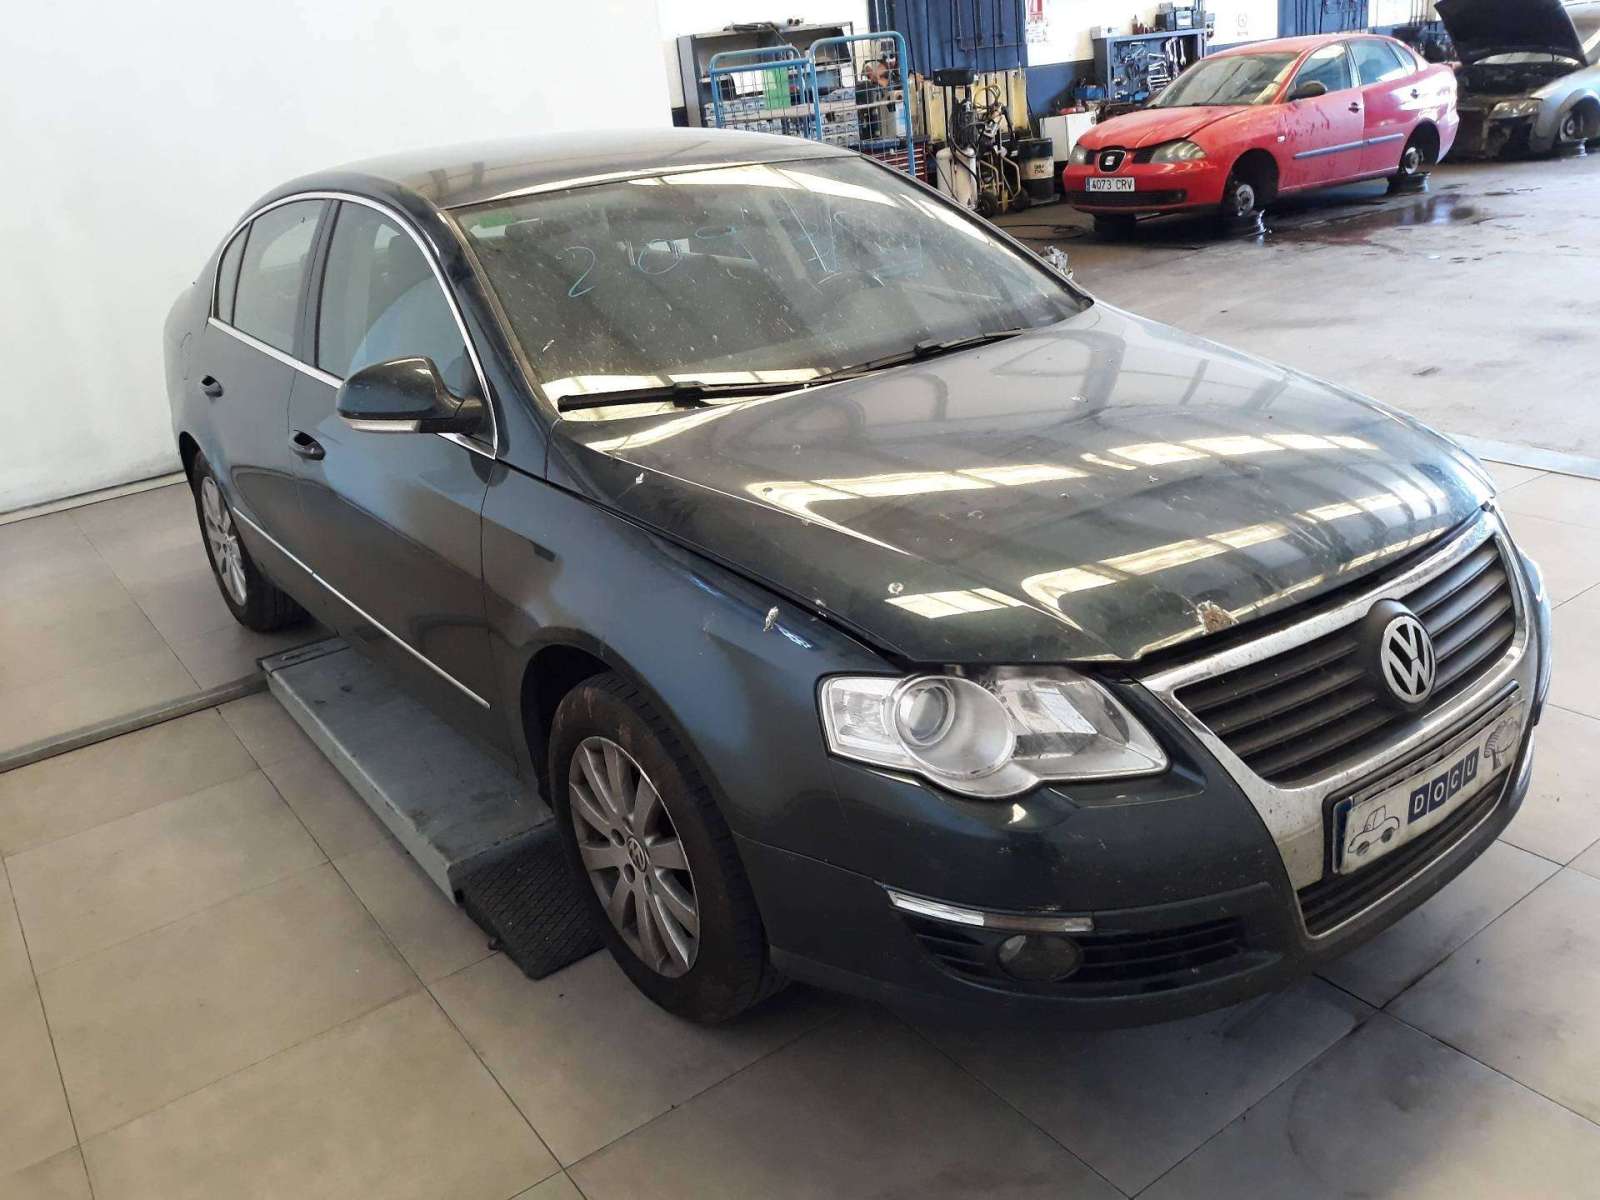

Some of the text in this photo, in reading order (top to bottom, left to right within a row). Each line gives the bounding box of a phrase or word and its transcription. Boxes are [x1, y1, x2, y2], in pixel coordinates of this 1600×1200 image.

[1091, 179, 1133, 190] 4073 CRV
[1413, 755, 1476, 815] DOCU
